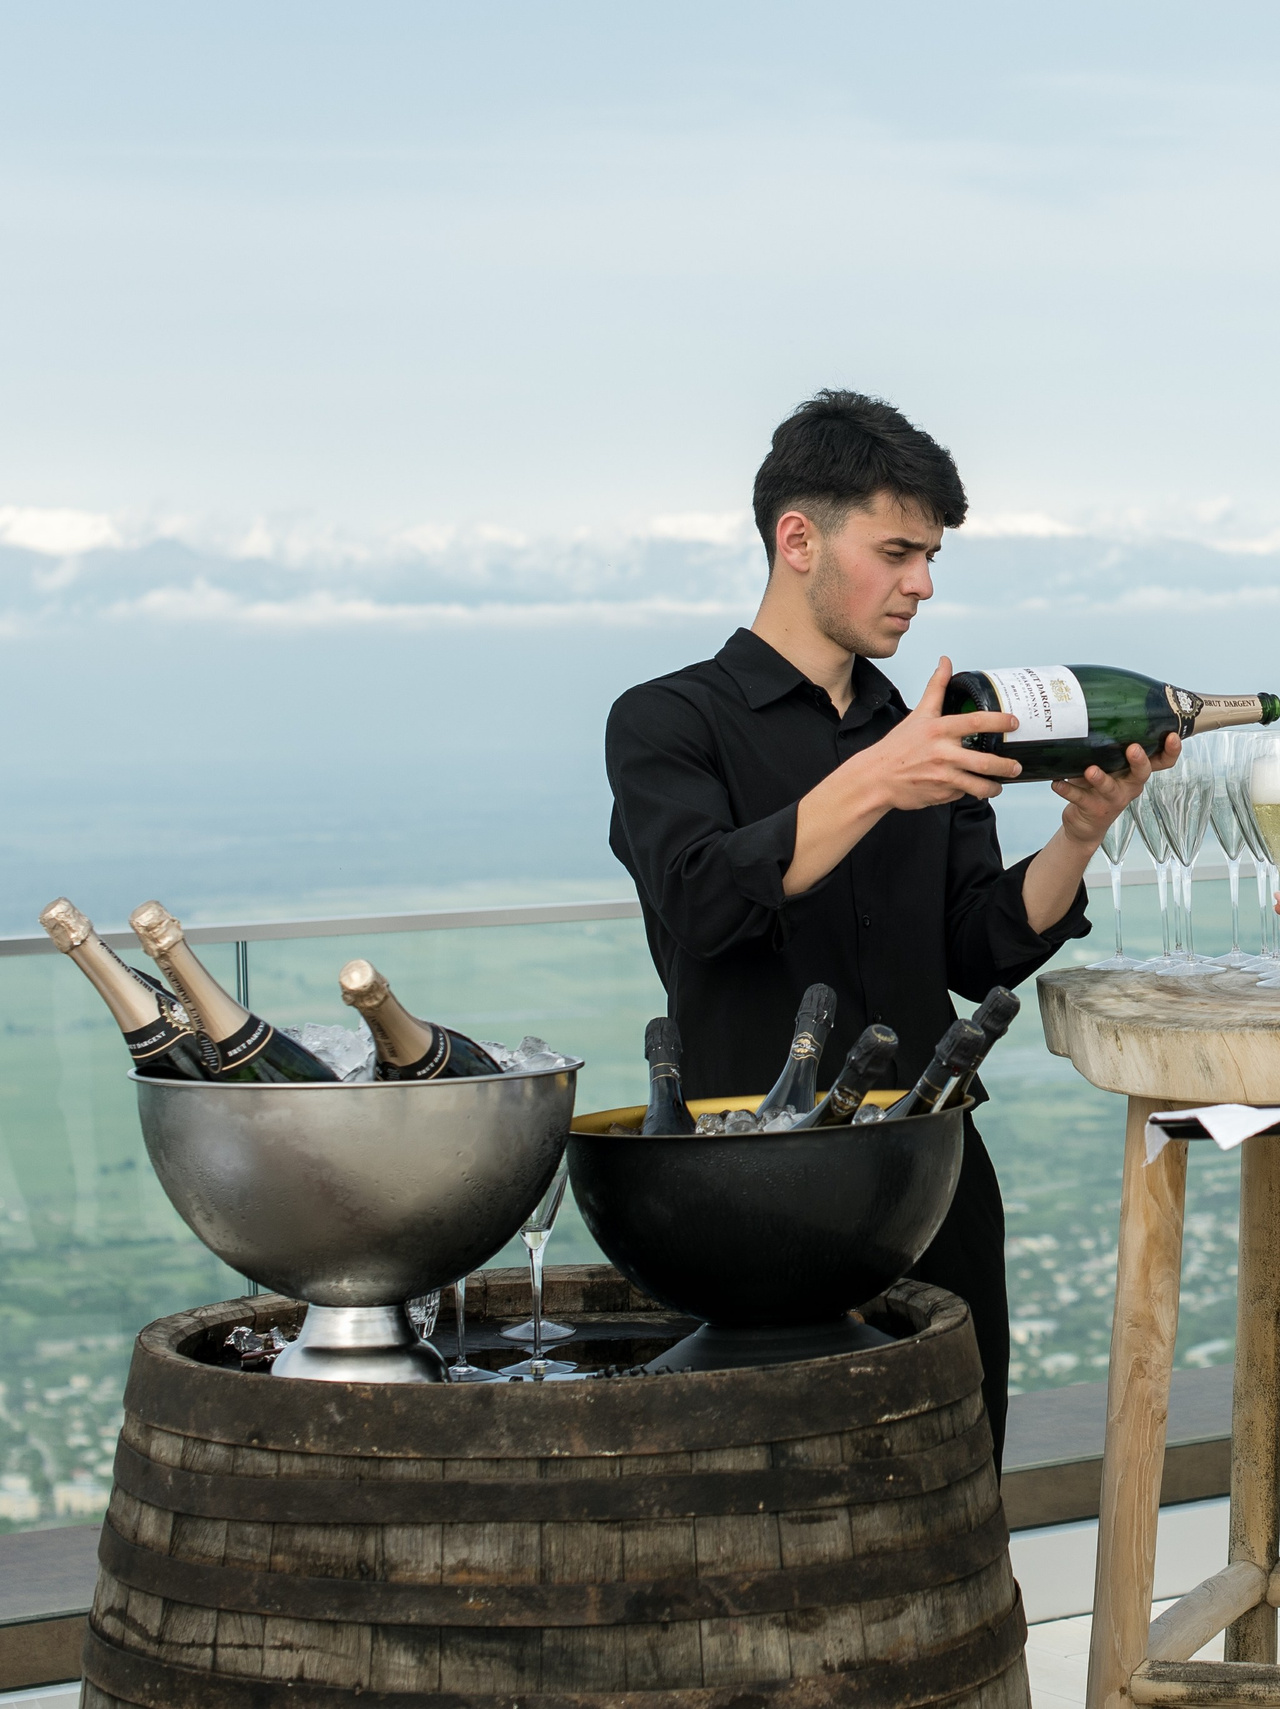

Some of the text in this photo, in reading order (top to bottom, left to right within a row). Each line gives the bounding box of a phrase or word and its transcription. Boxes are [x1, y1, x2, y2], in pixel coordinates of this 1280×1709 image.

[1010, 684, 1021, 701] BRUT
[1018, 672, 1040, 718] CHARDONNAY
[1023, 668, 1053, 729] BRUT DARGENT
[1204, 699, 1256, 707] BRUT DARGENT
[163, 966, 206, 1031] BRUT DARGENT
[136, 1030, 167, 1049] DARGENT
[226, 1041, 248, 1058] BRUT
